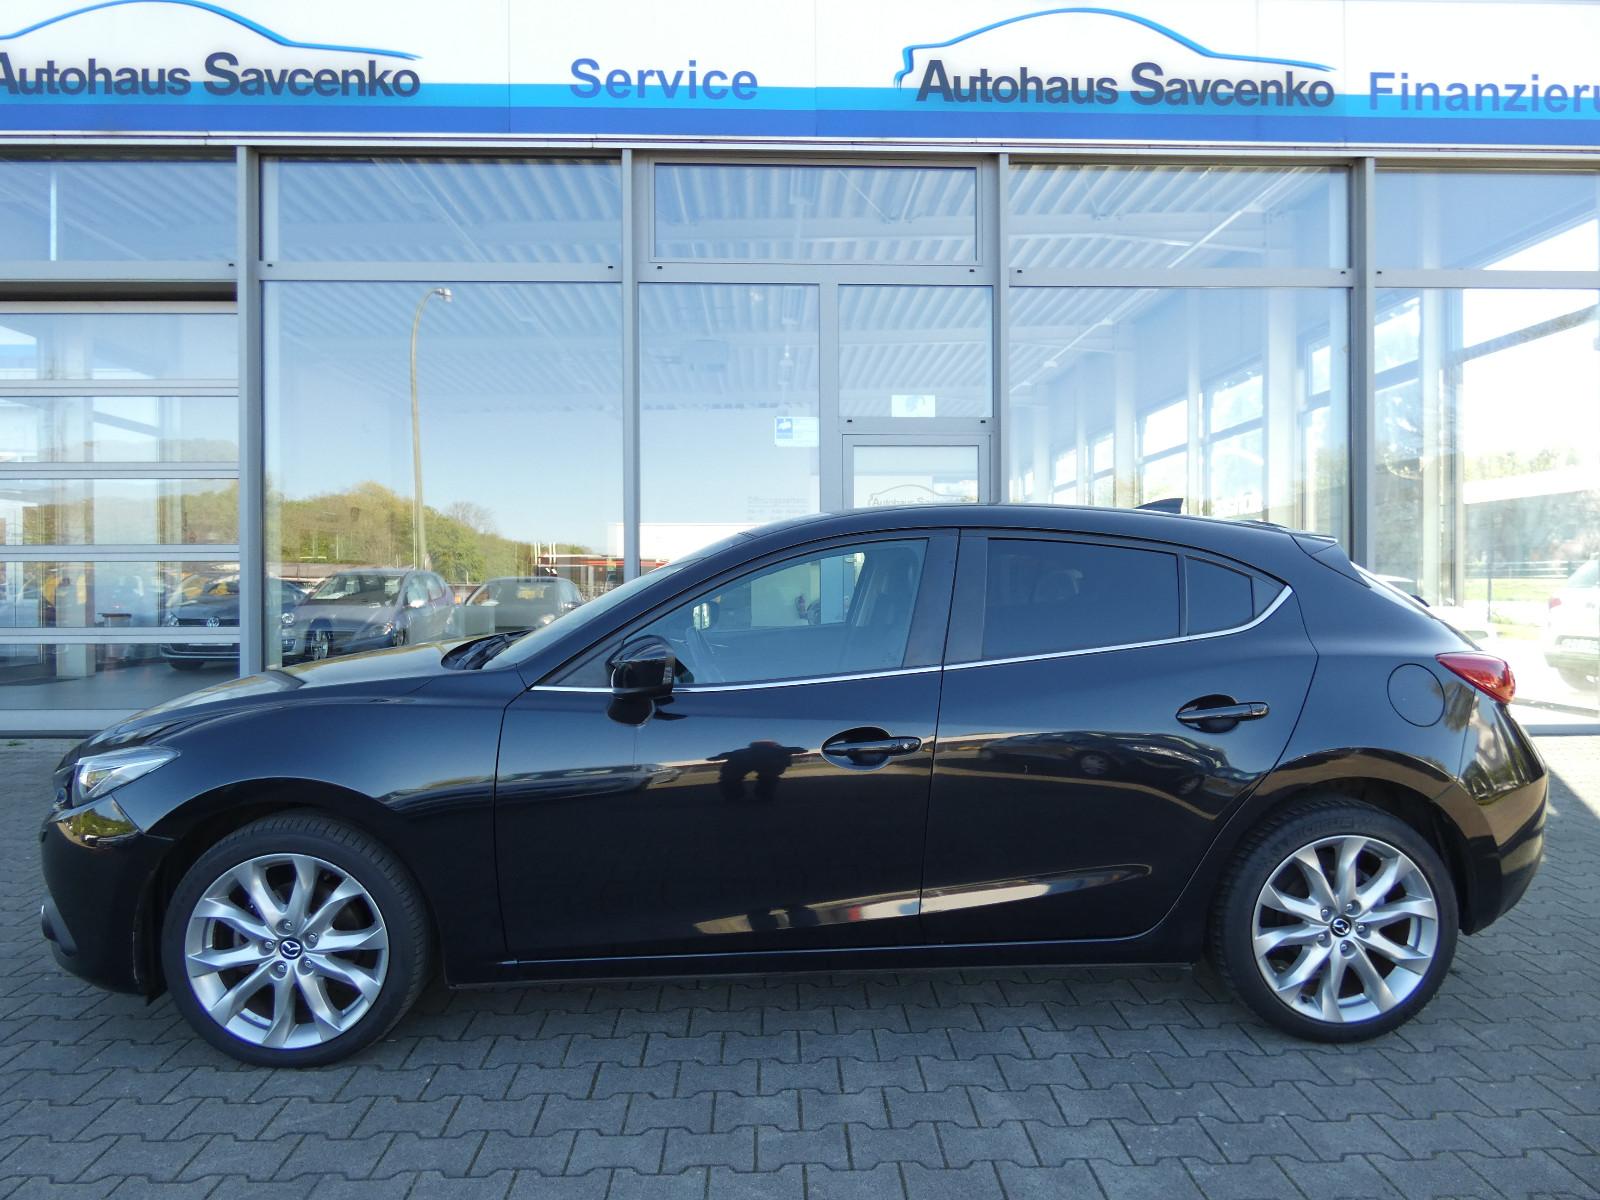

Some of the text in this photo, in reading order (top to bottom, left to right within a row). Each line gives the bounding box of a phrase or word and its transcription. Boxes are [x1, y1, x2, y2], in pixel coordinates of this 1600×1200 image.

[203, 51, 421, 97] Savcenko
[570, 57, 758, 100] Service
[916, 59, 1335, 107] Autohaus Savcenko
